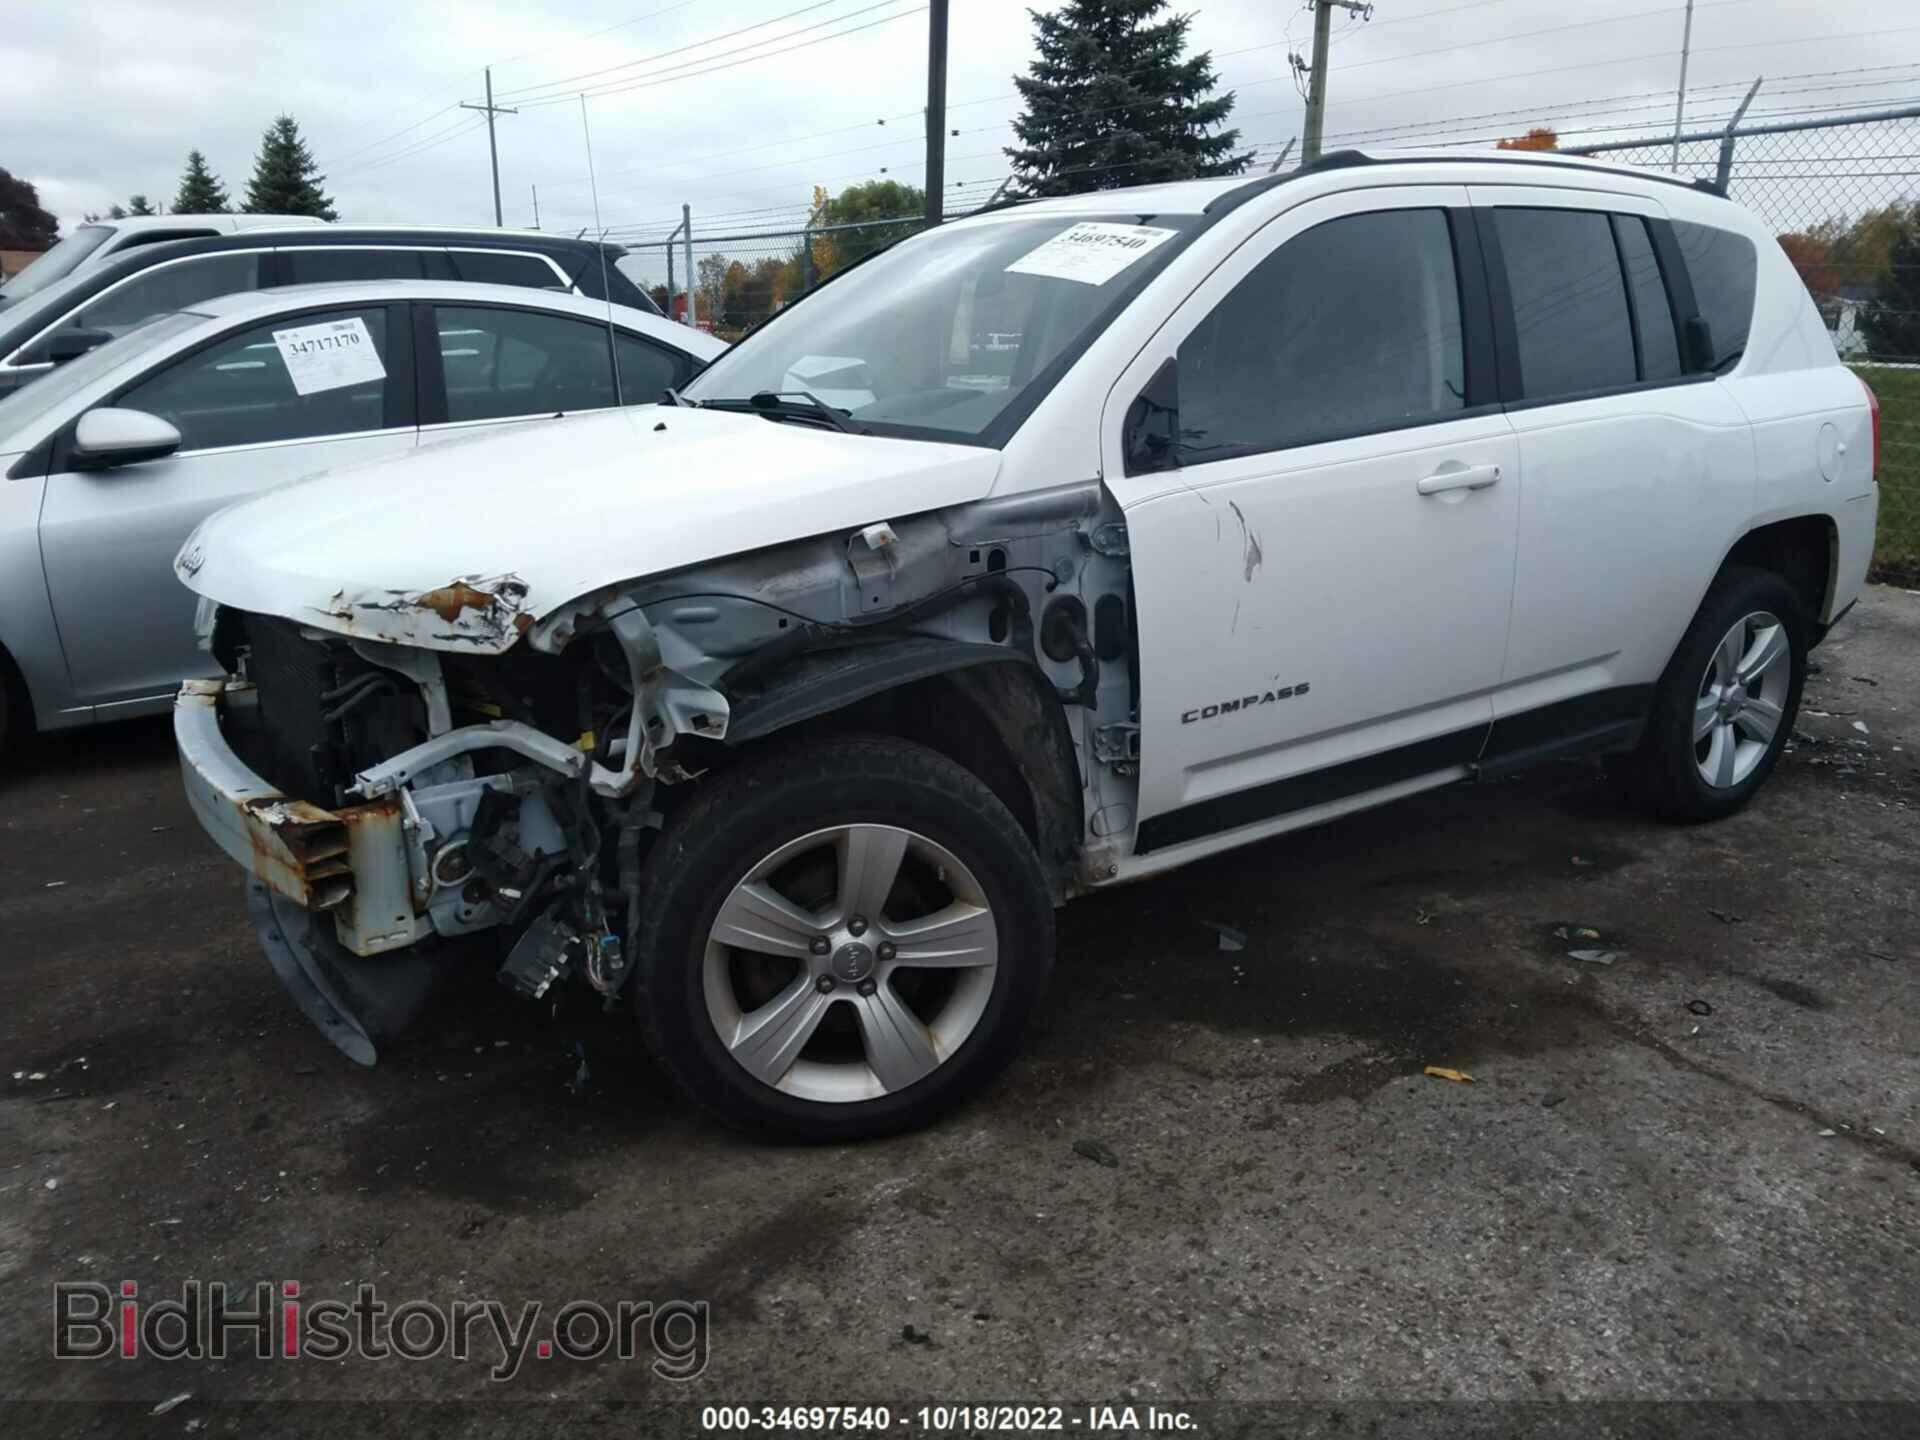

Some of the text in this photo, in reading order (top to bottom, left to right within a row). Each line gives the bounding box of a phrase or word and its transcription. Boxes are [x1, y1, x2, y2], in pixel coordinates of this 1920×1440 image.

[1061, 231, 1148, 249] 34697540
[289, 332, 360, 356] 34717170
[1181, 682, 1310, 724] COMPASS
